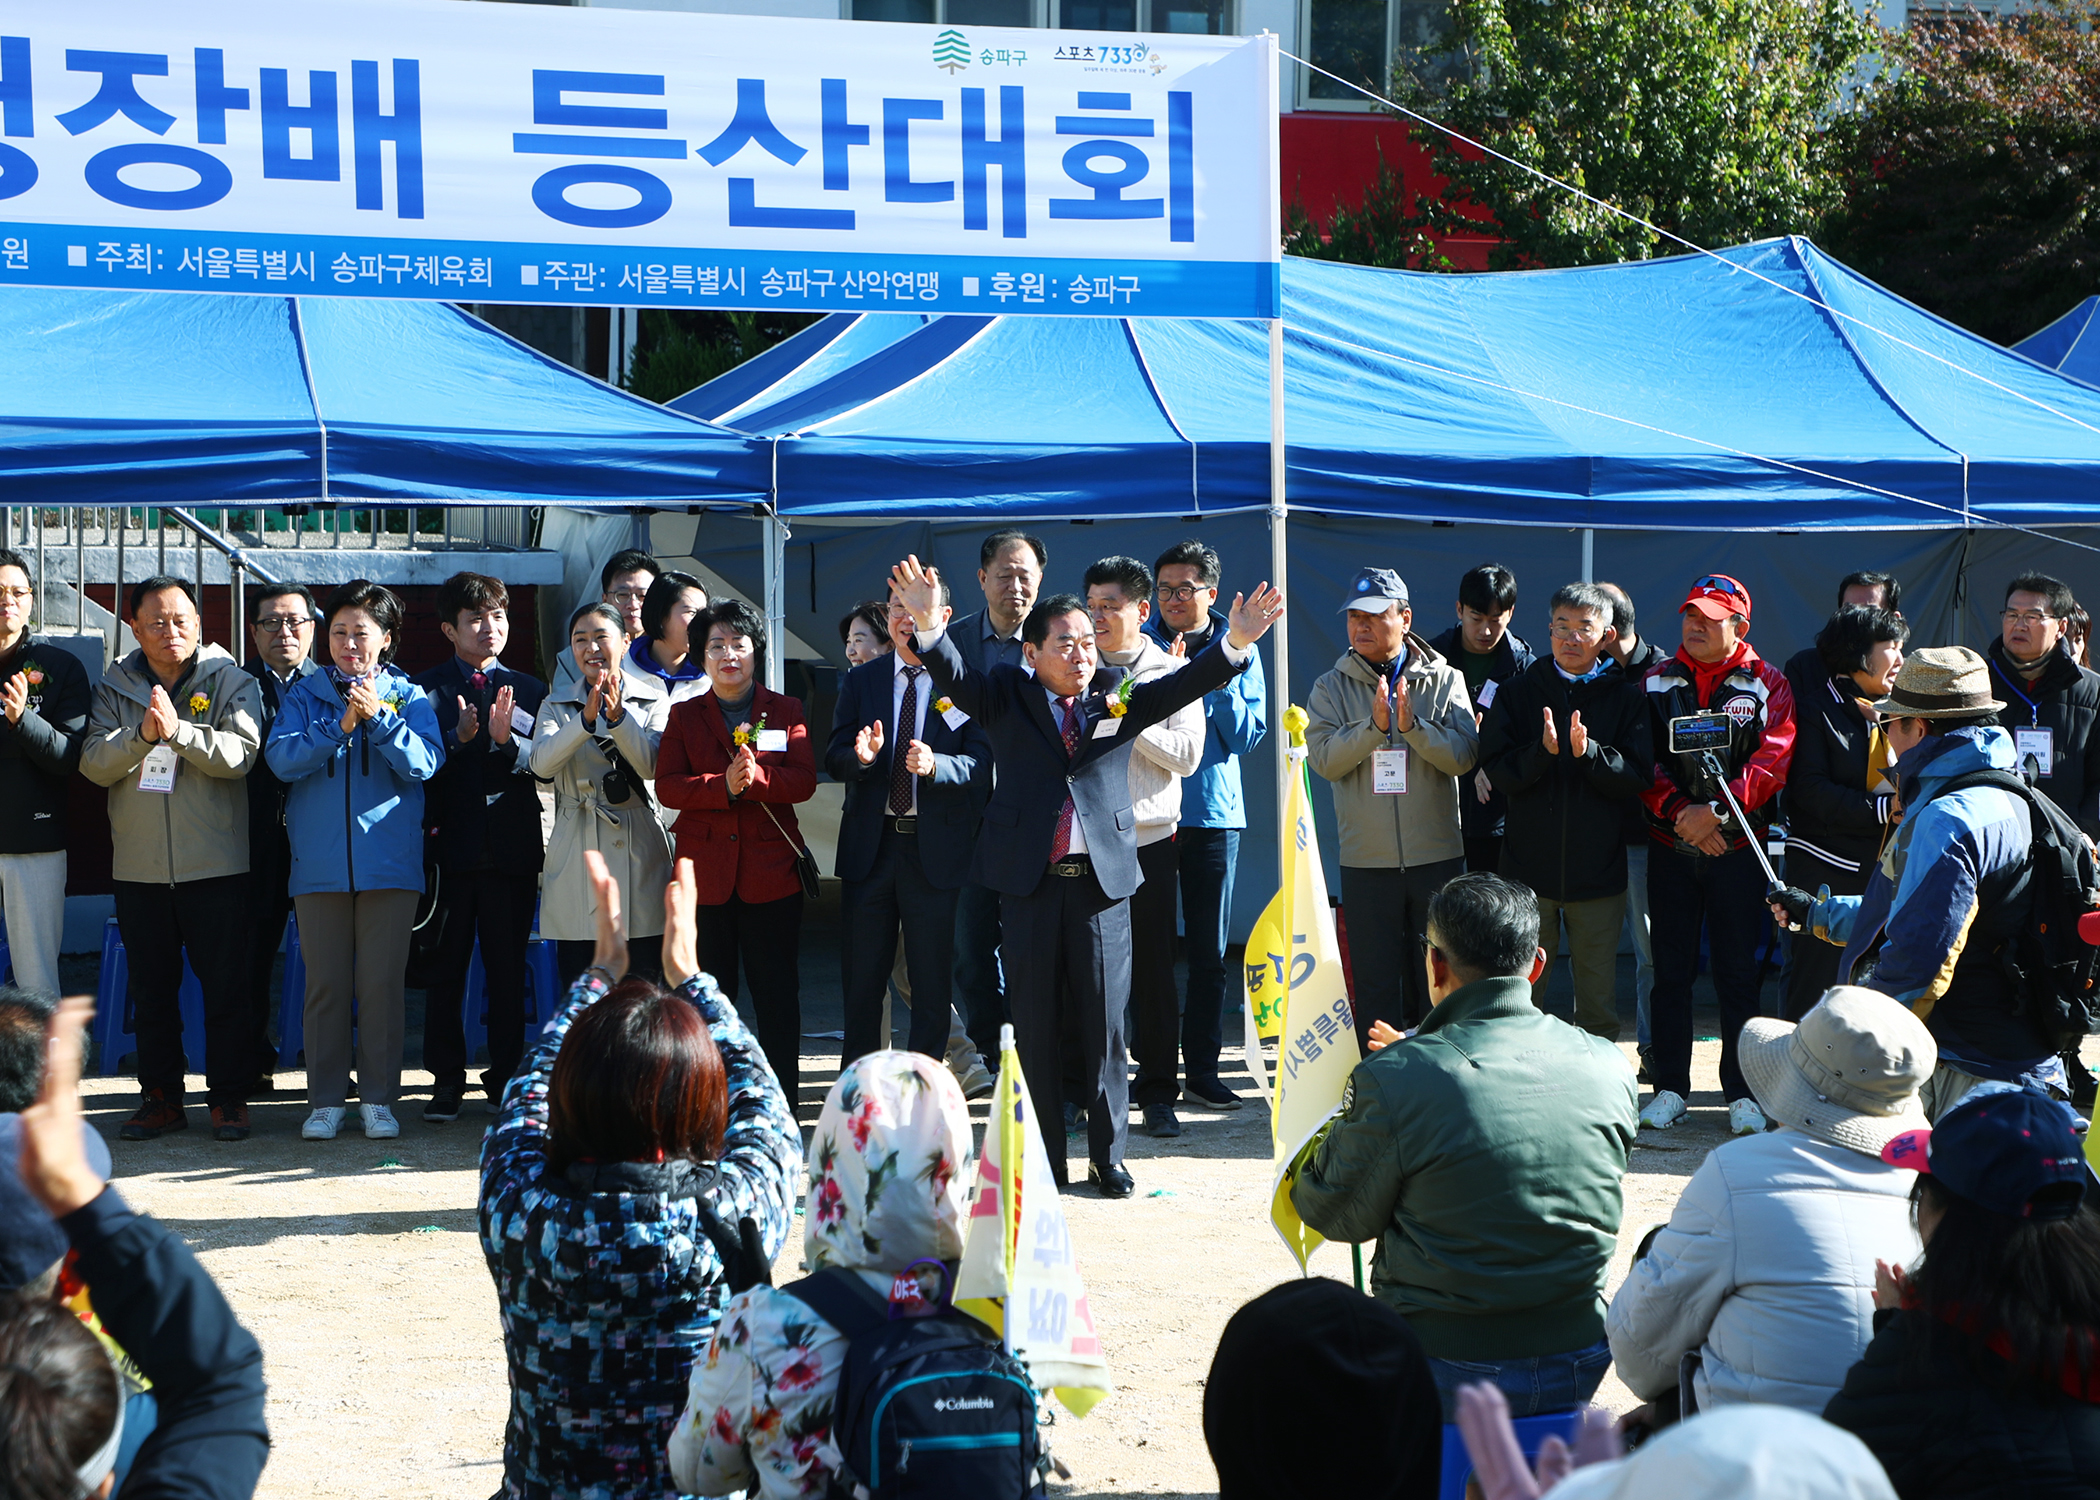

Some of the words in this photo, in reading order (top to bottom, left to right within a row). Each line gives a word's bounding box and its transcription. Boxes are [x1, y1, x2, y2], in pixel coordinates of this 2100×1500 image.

[979, 48, 1028, 66] 송파구
[513, 69, 1195, 243] 등산대회
[177, 246, 315, 282] 서울특별시
[331, 252, 492, 288] 송파구체육회
[618, 264, 746, 297] 서울특별시
[1068, 274, 1141, 304] 송파구
[946, 1396, 994, 1411] Columbia
